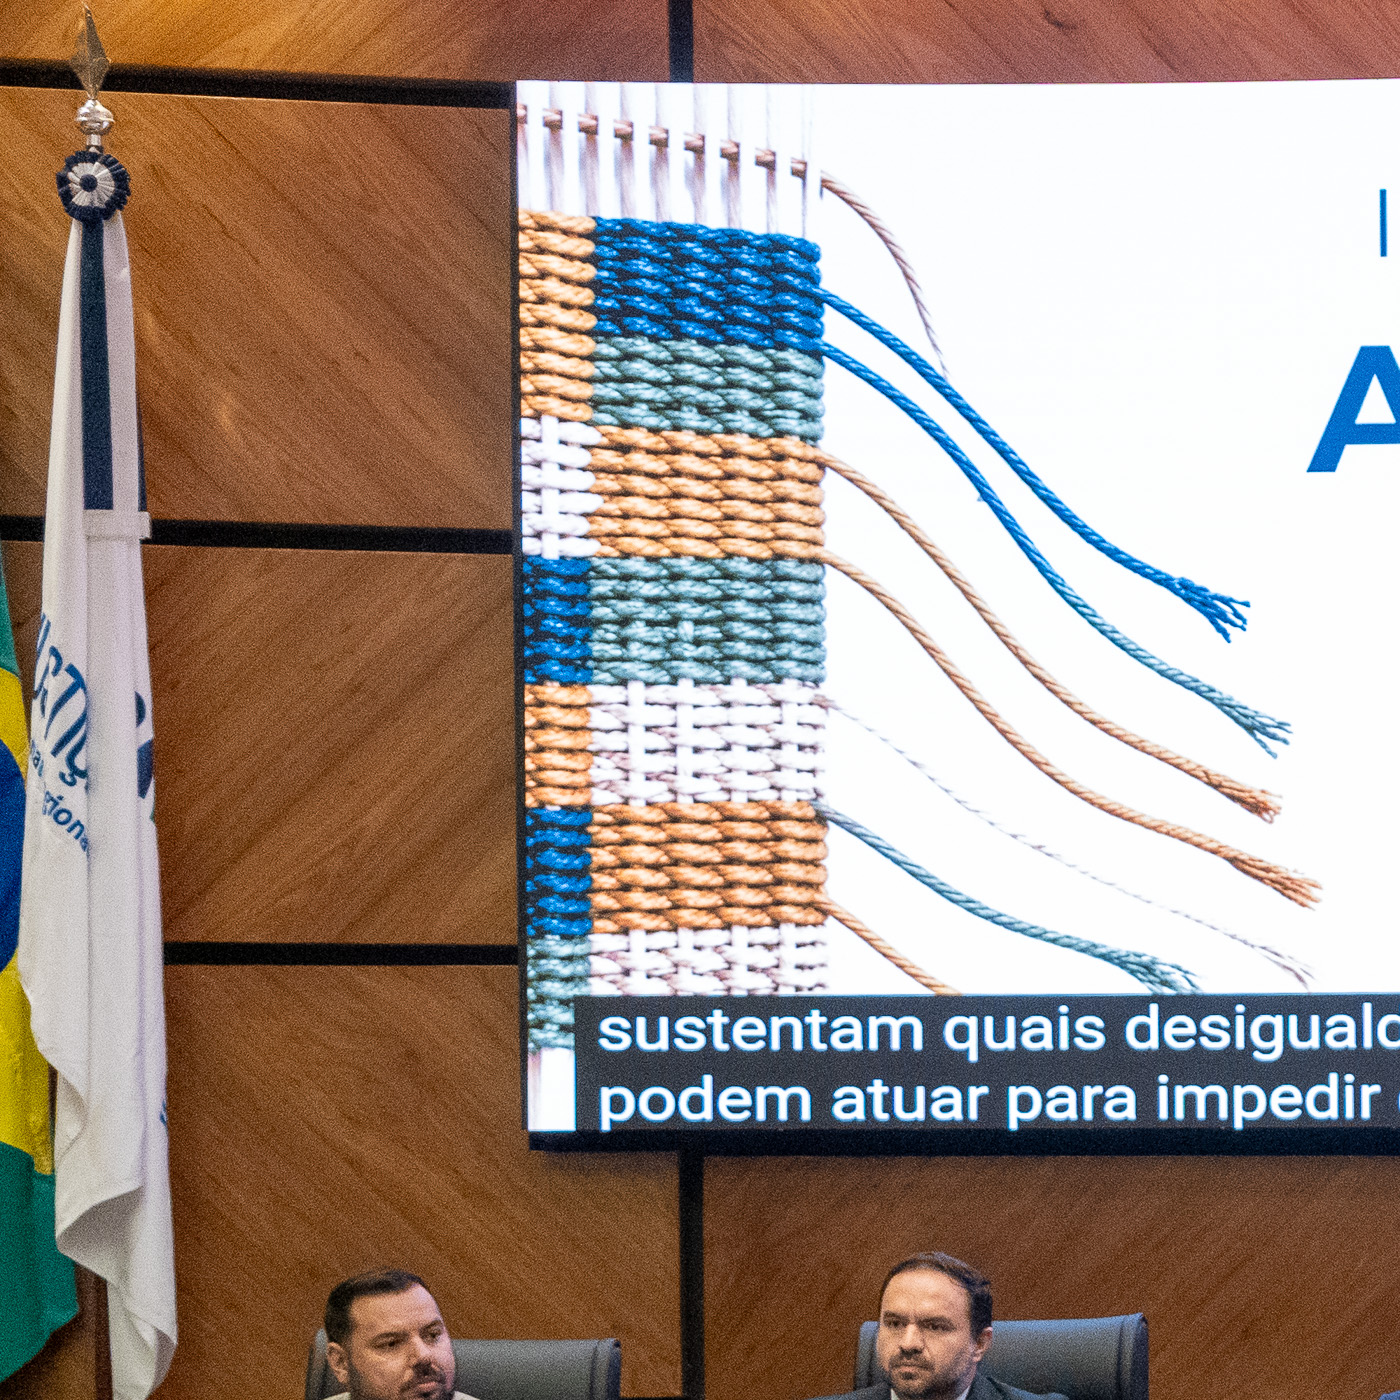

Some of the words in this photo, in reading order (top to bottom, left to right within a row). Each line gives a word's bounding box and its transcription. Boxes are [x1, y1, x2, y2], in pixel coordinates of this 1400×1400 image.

[599, 1010, 922, 1050] sustentam
[945, 1005, 1105, 1061] quais
[601, 1075, 810, 1130] podem
[834, 1080, 988, 1120] atuar
[1009, 1086, 1136, 1130] para
[1159, 1073, 1381, 1129] impedir
